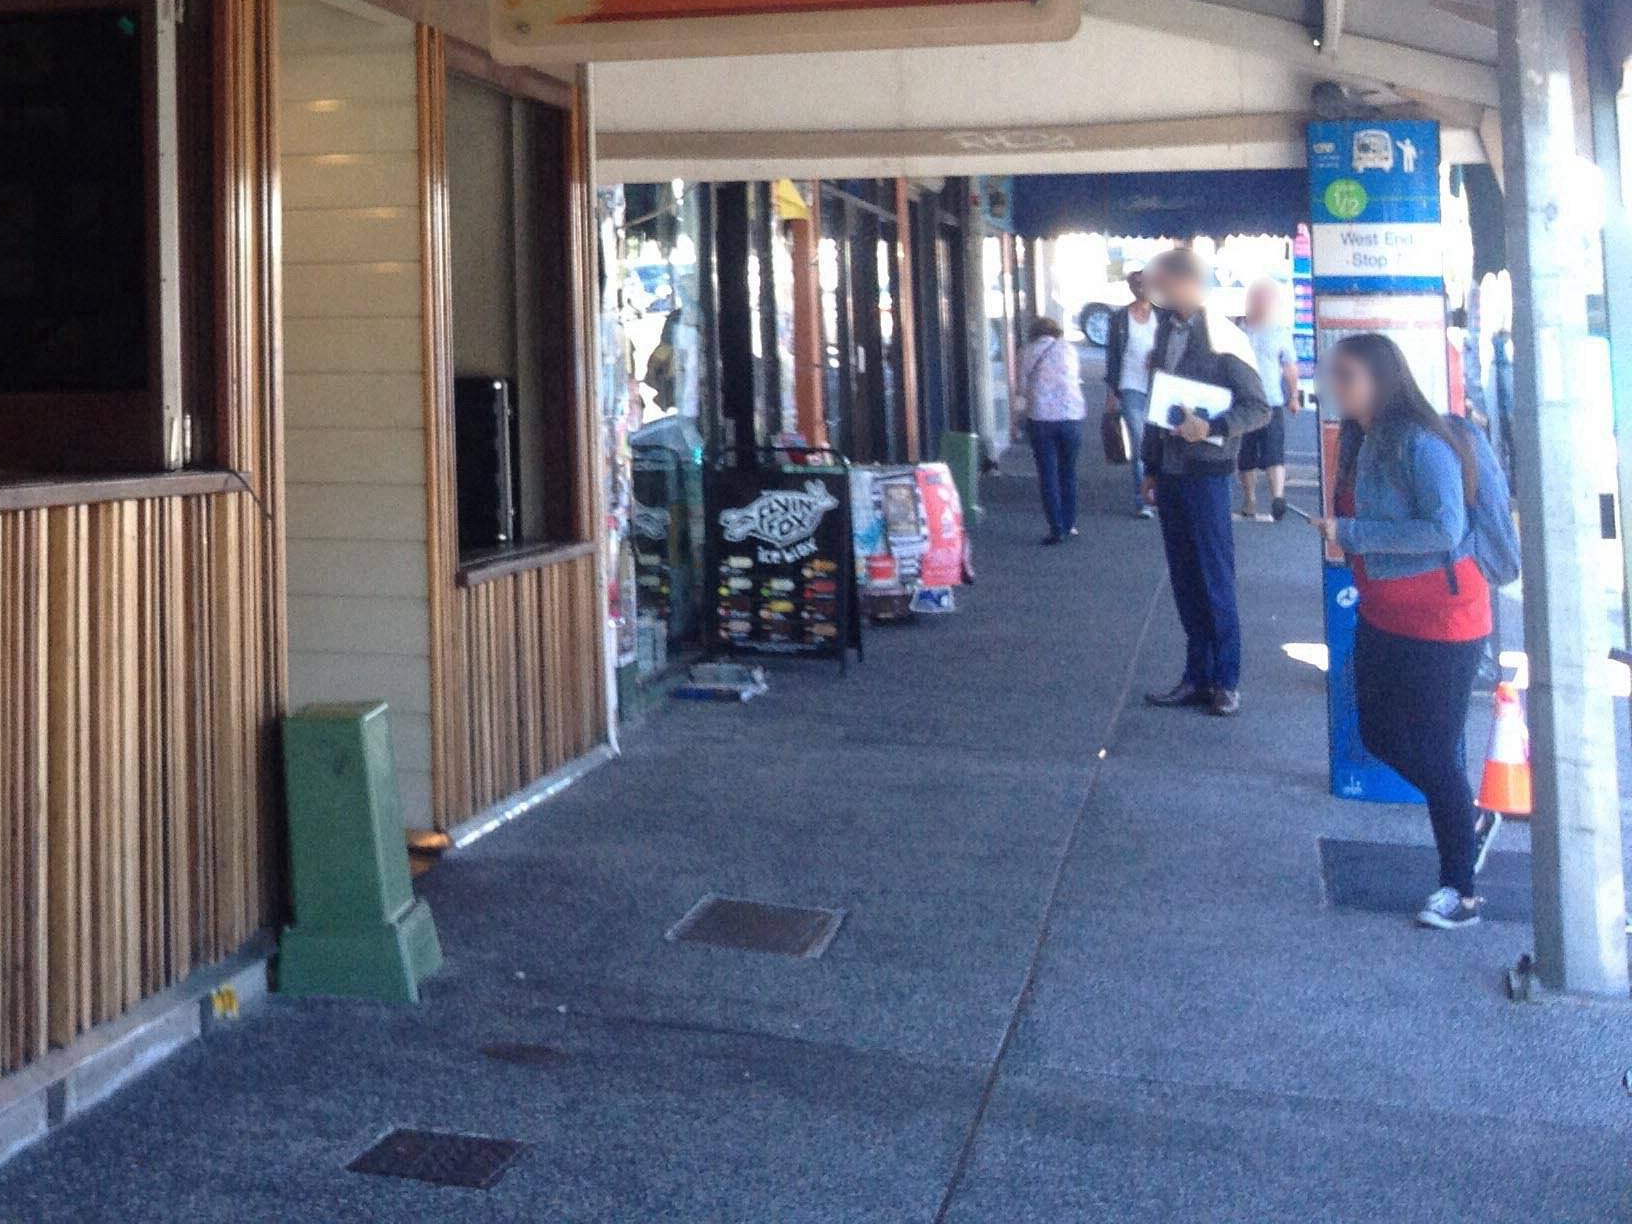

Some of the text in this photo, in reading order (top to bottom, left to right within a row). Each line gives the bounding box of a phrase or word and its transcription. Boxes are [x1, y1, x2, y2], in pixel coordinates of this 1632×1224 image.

[1341, 231, 1414, 247] West End
[1352, 251, 1388, 269] Stop
